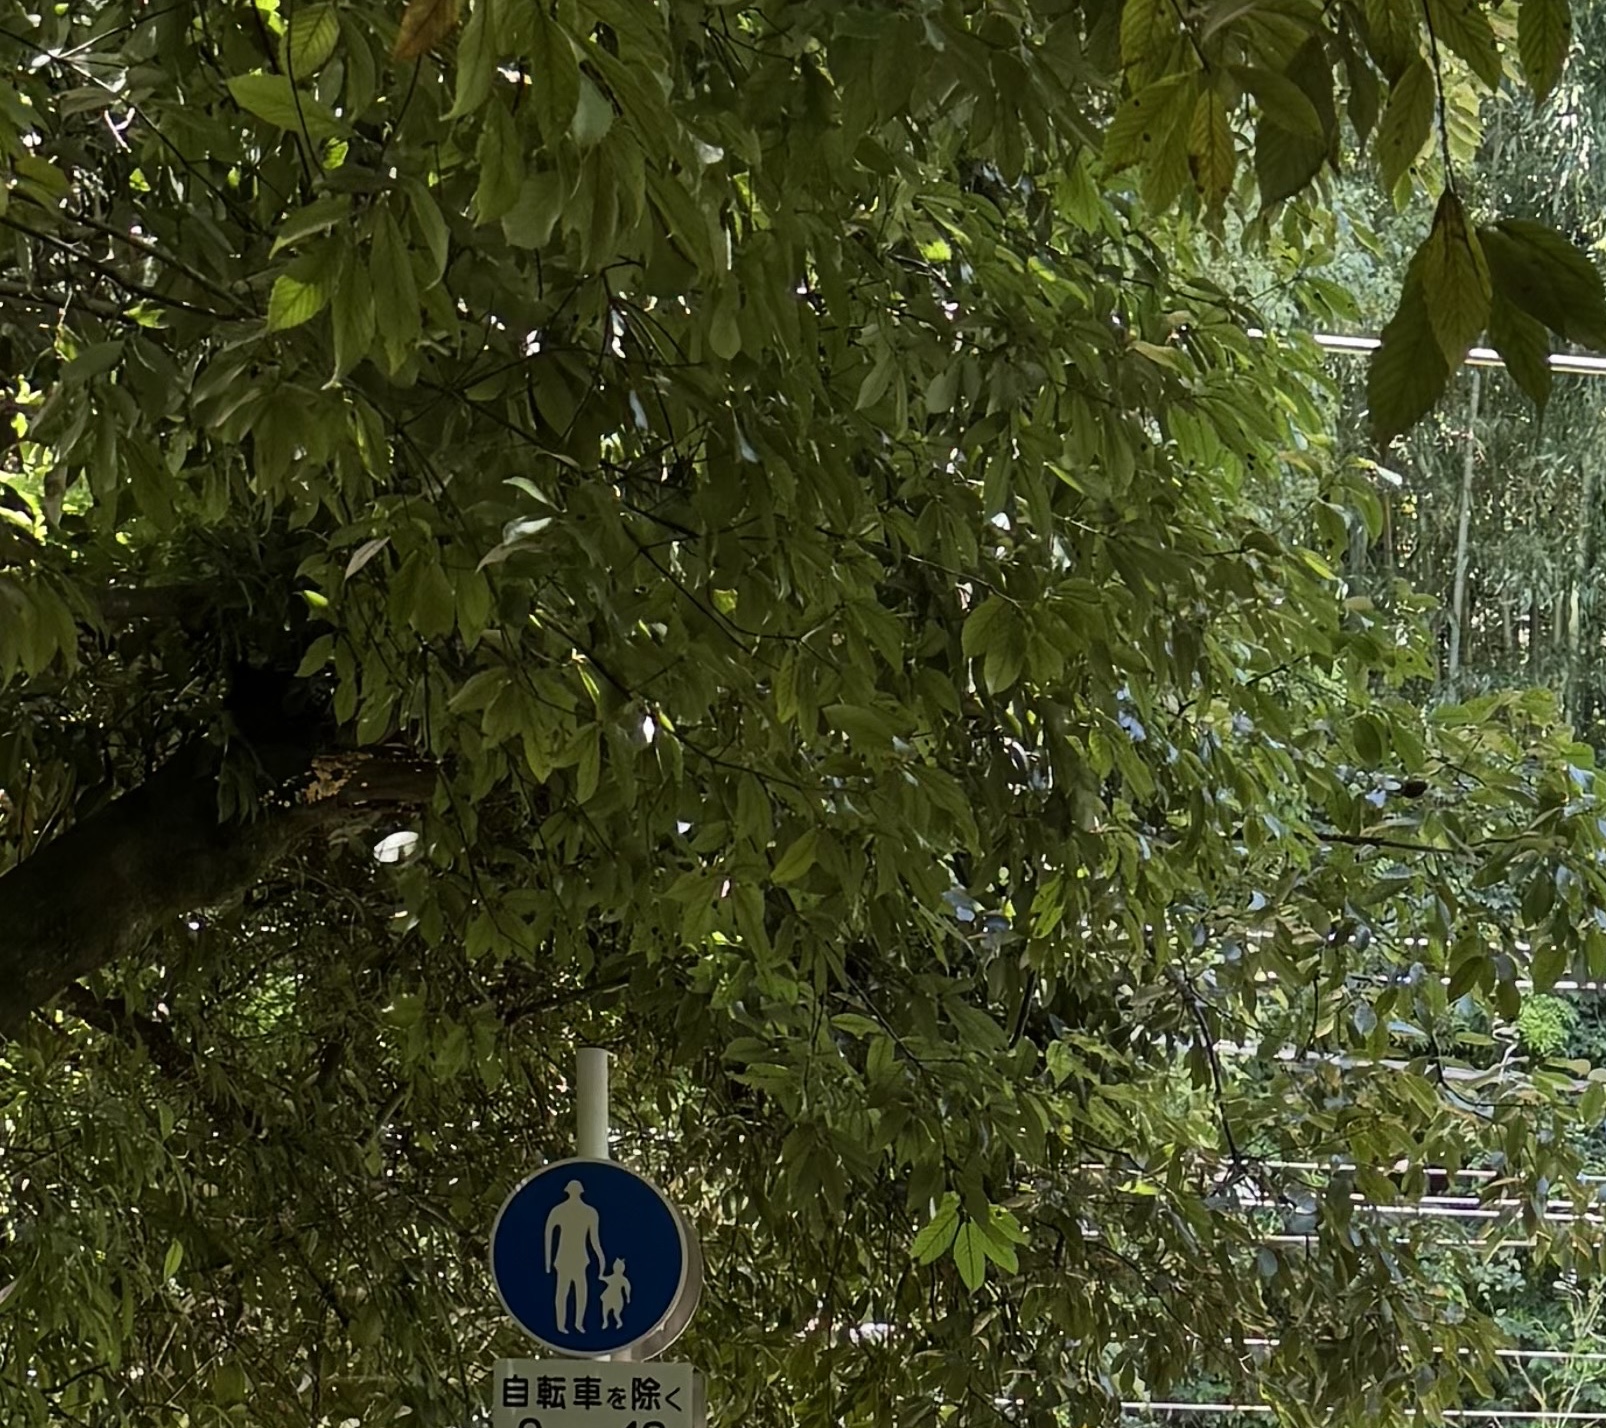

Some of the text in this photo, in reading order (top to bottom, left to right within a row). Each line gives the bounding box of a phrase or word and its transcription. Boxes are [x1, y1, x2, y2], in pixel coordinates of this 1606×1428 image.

[502, 1374, 683, 1412] 自転車を除く
